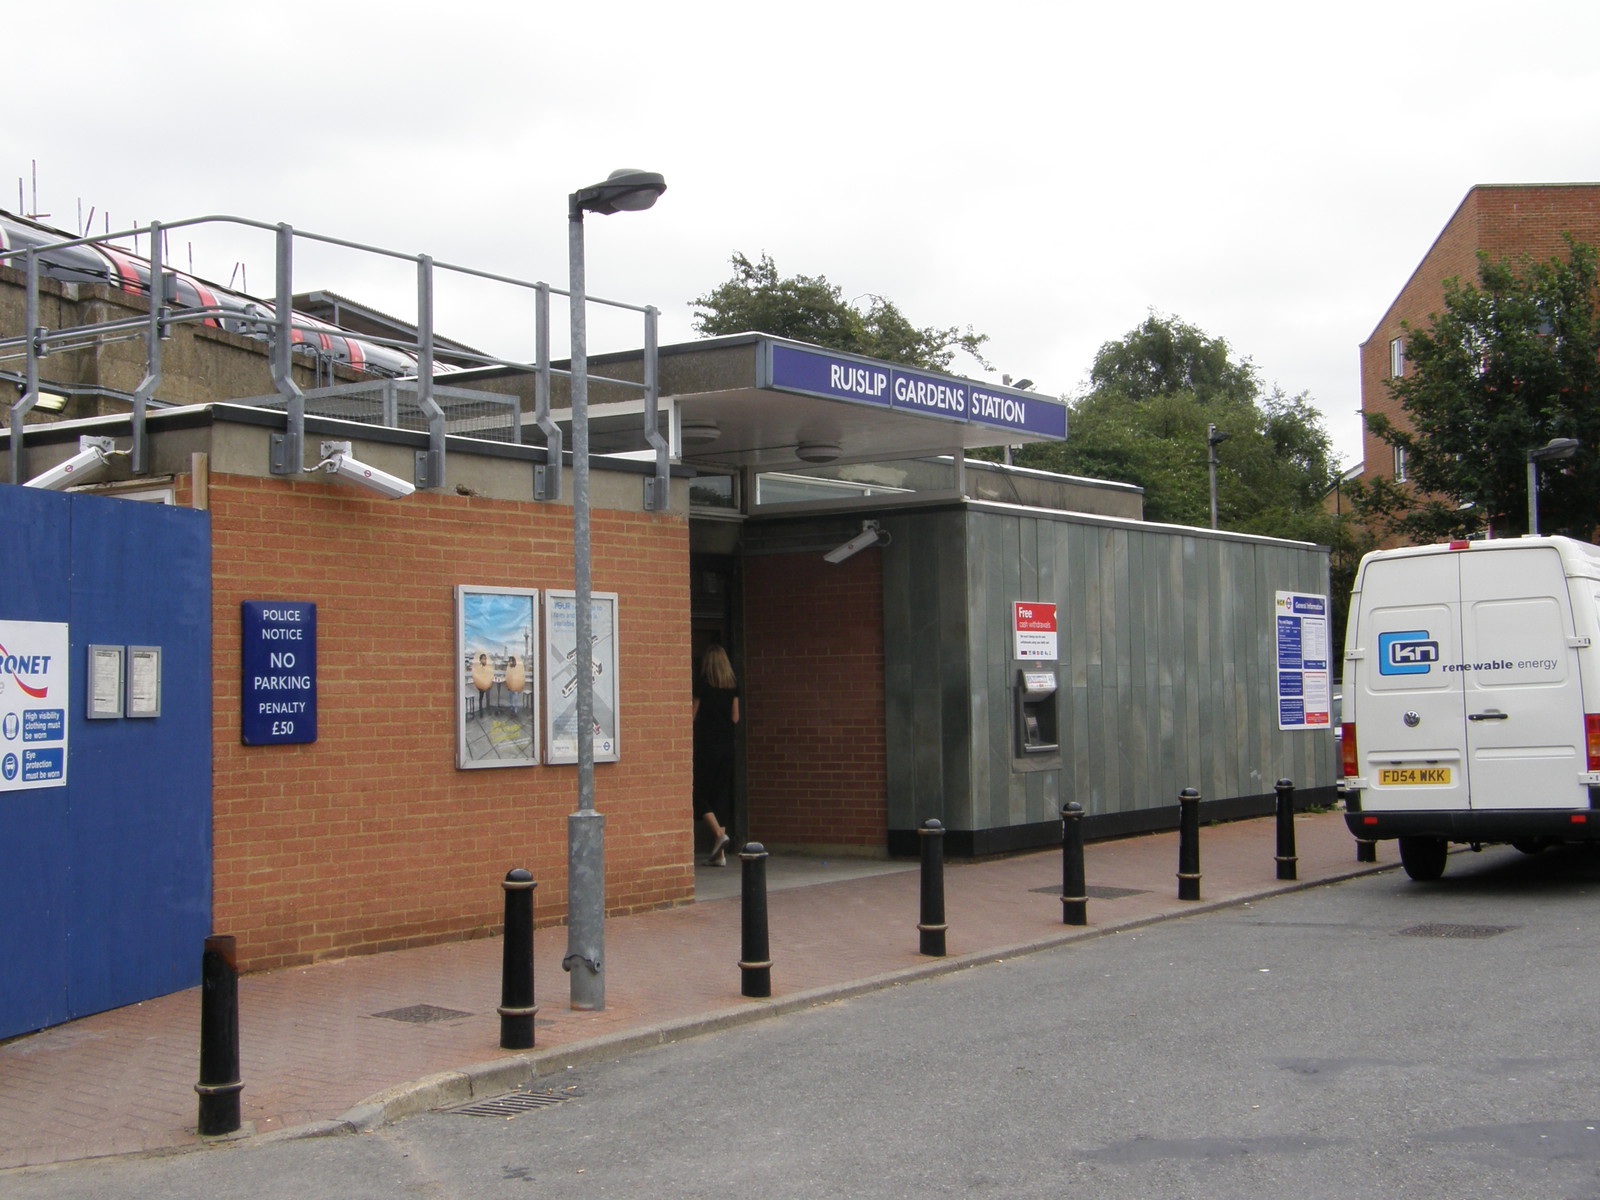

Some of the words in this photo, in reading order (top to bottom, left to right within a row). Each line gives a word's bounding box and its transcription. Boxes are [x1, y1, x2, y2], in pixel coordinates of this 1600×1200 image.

[830, 364, 887, 396] RUISLIP
[894, 377, 965, 412] GARDENS
[971, 393, 1025, 424] STATION
[262, 609, 302, 622] POLICE
[1018, 606, 1033, 618] Free
[261, 628, 303, 640] NOTICE
[270, 652, 296, 669] NO
[1442, 659, 1513, 673] renewable
[1518, 659, 1558, 672] energy
[254, 675, 311, 690] PARKING
[258, 701, 306, 714] PENALTY
[25, 711, 38, 721] High
[39, 711, 60, 721] visibility
[25, 722, 46, 731] clothing
[47, 721, 61, 729] must
[272, 721, 294, 735] £50
[24, 731, 32, 740] be
[26, 750, 36, 760] Eye
[26, 760, 53, 771] protection
[26, 771, 39, 779] must
[47, 769, 61, 777] worn
[1383, 769, 1416, 783] FD54
[1419, 769, 1445, 782] WKK
